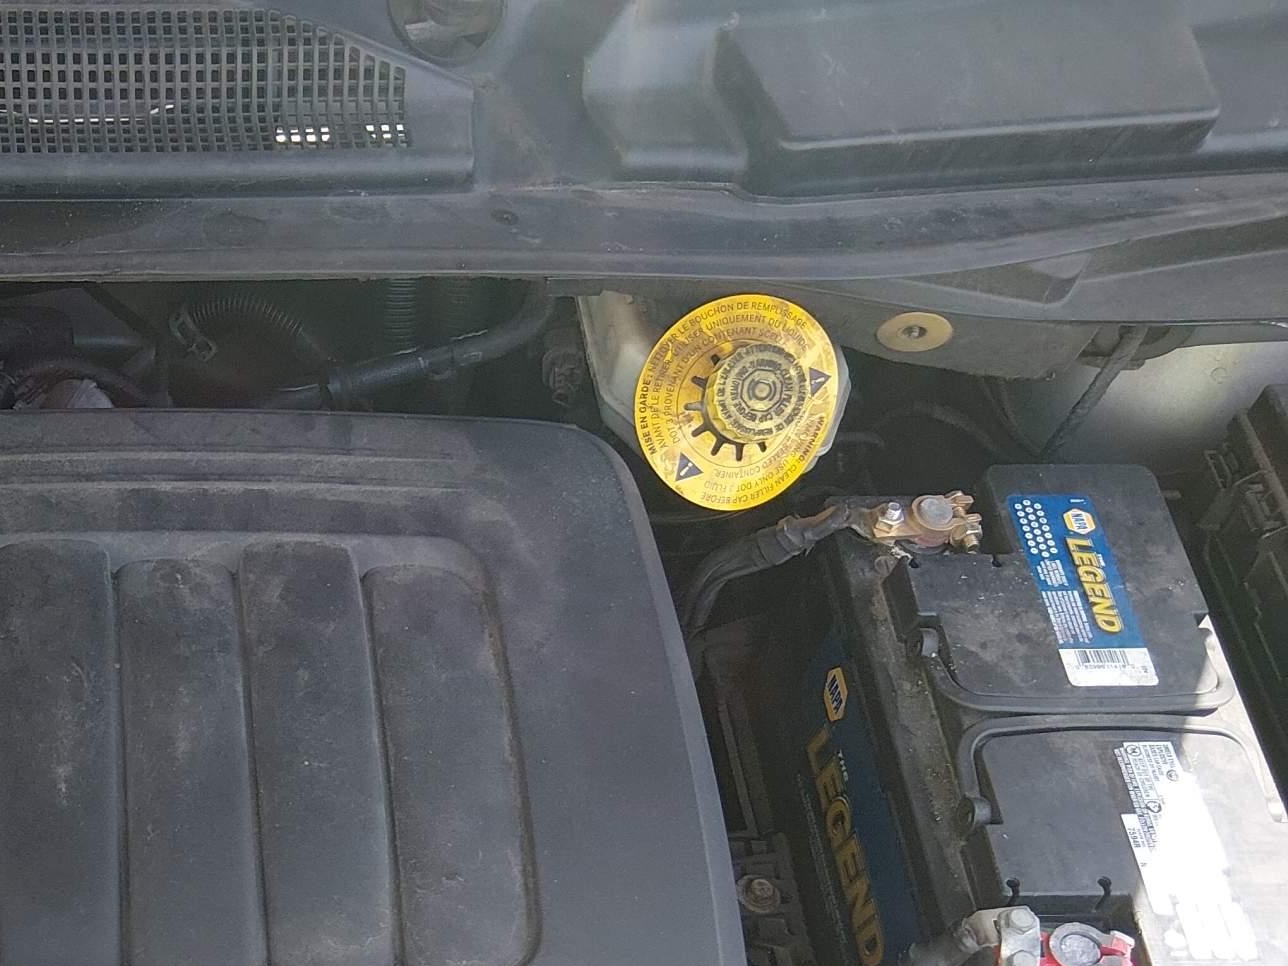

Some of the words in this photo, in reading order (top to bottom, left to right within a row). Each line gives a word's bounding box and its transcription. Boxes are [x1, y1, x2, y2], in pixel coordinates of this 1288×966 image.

[688, 302, 734, 326] BOUCHON
[737, 302, 749, 310] DE
[678, 324, 689, 334] LE
[653, 420, 669, 450] AVANT
[706, 314, 766, 330] UNIQUEMENT
[640, 416, 648, 430] EN
[641, 431, 657, 455] MISE
[668, 427, 680, 447] DOT
[797, 416, 825, 463] WARNING:
[753, 472, 774, 487] ONLY
[774, 464, 797, 486] CLEAN
[736, 482, 753, 492] DOT
[750, 481, 777, 500] FILLER
[700, 492, 733, 504] BEFORE
[733, 493, 750, 503] CAP
[1071, 511, 1088, 530] NAPA
[1066, 537, 1124, 633] LEGEND
[826, 673, 843, 713] NAPA
[837, 750, 849, 781] THE
